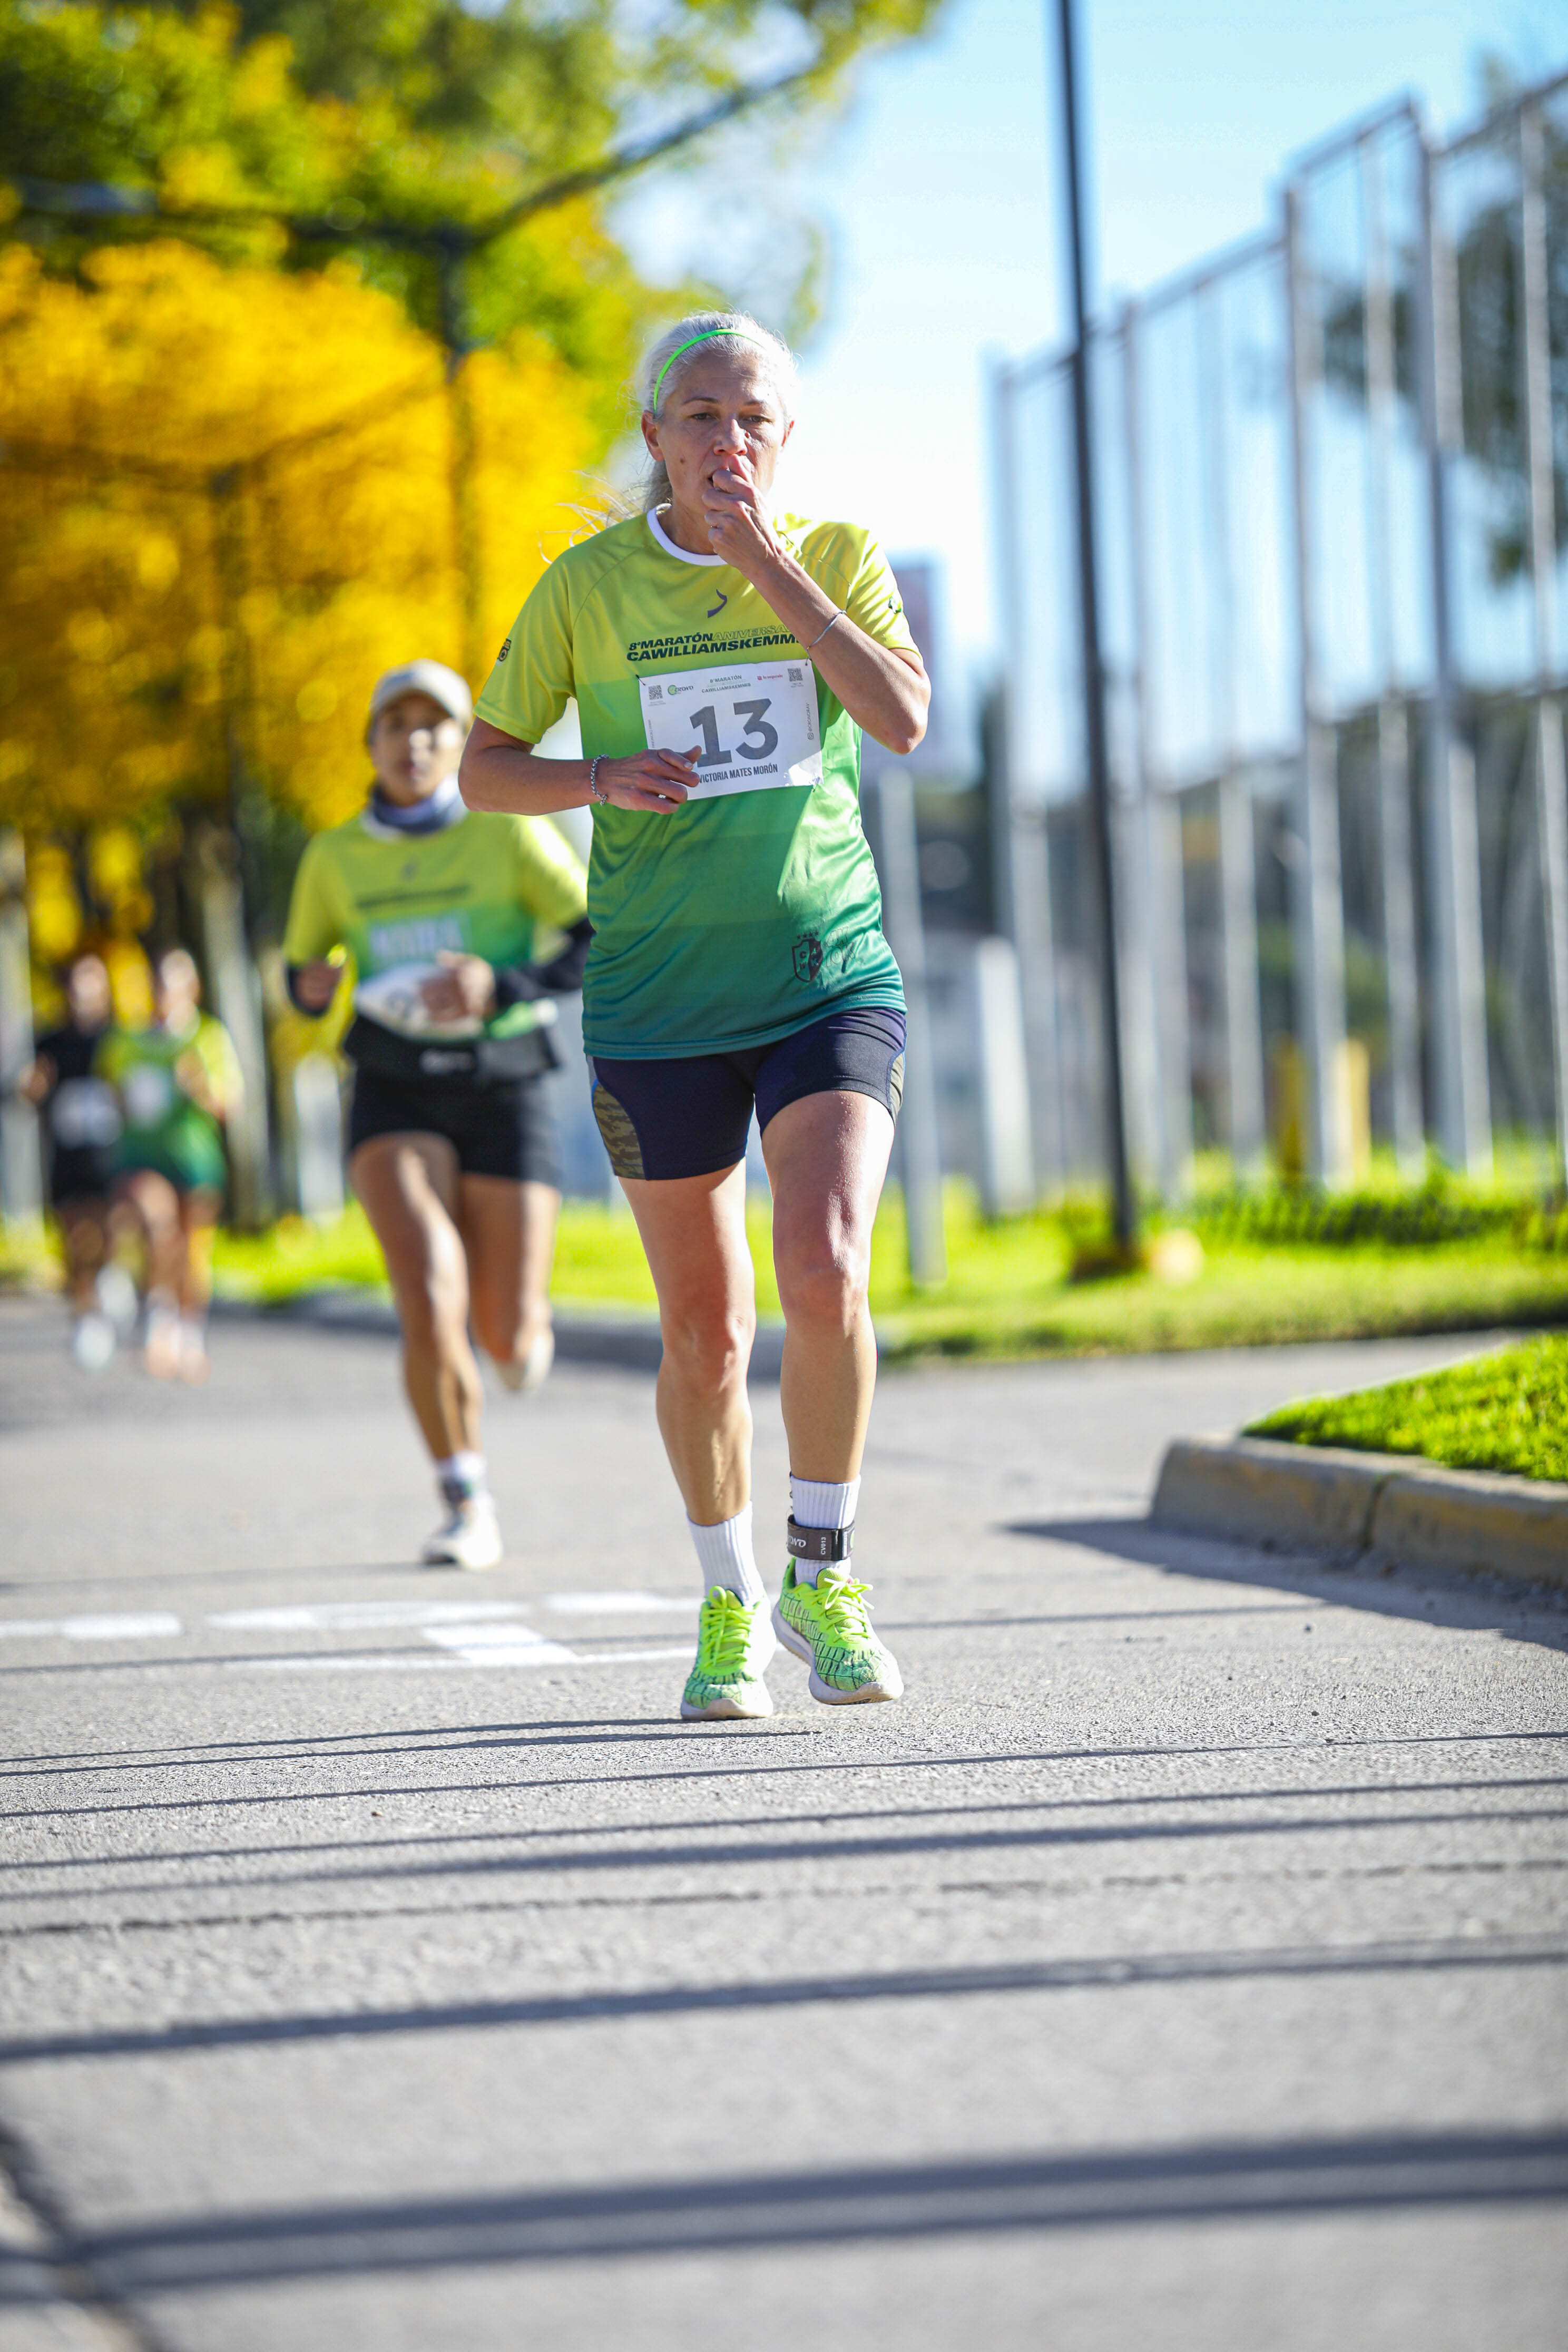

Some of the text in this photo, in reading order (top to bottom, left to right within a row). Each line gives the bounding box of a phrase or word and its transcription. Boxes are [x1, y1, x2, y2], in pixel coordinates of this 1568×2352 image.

[712, 624, 790, 641] ANIVERSA
[626, 633, 799, 661] CAWILLIAMSKEMM
[690, 698, 778, 767] 13
[699, 763, 778, 783] VICTORIA MATES MORÓN
